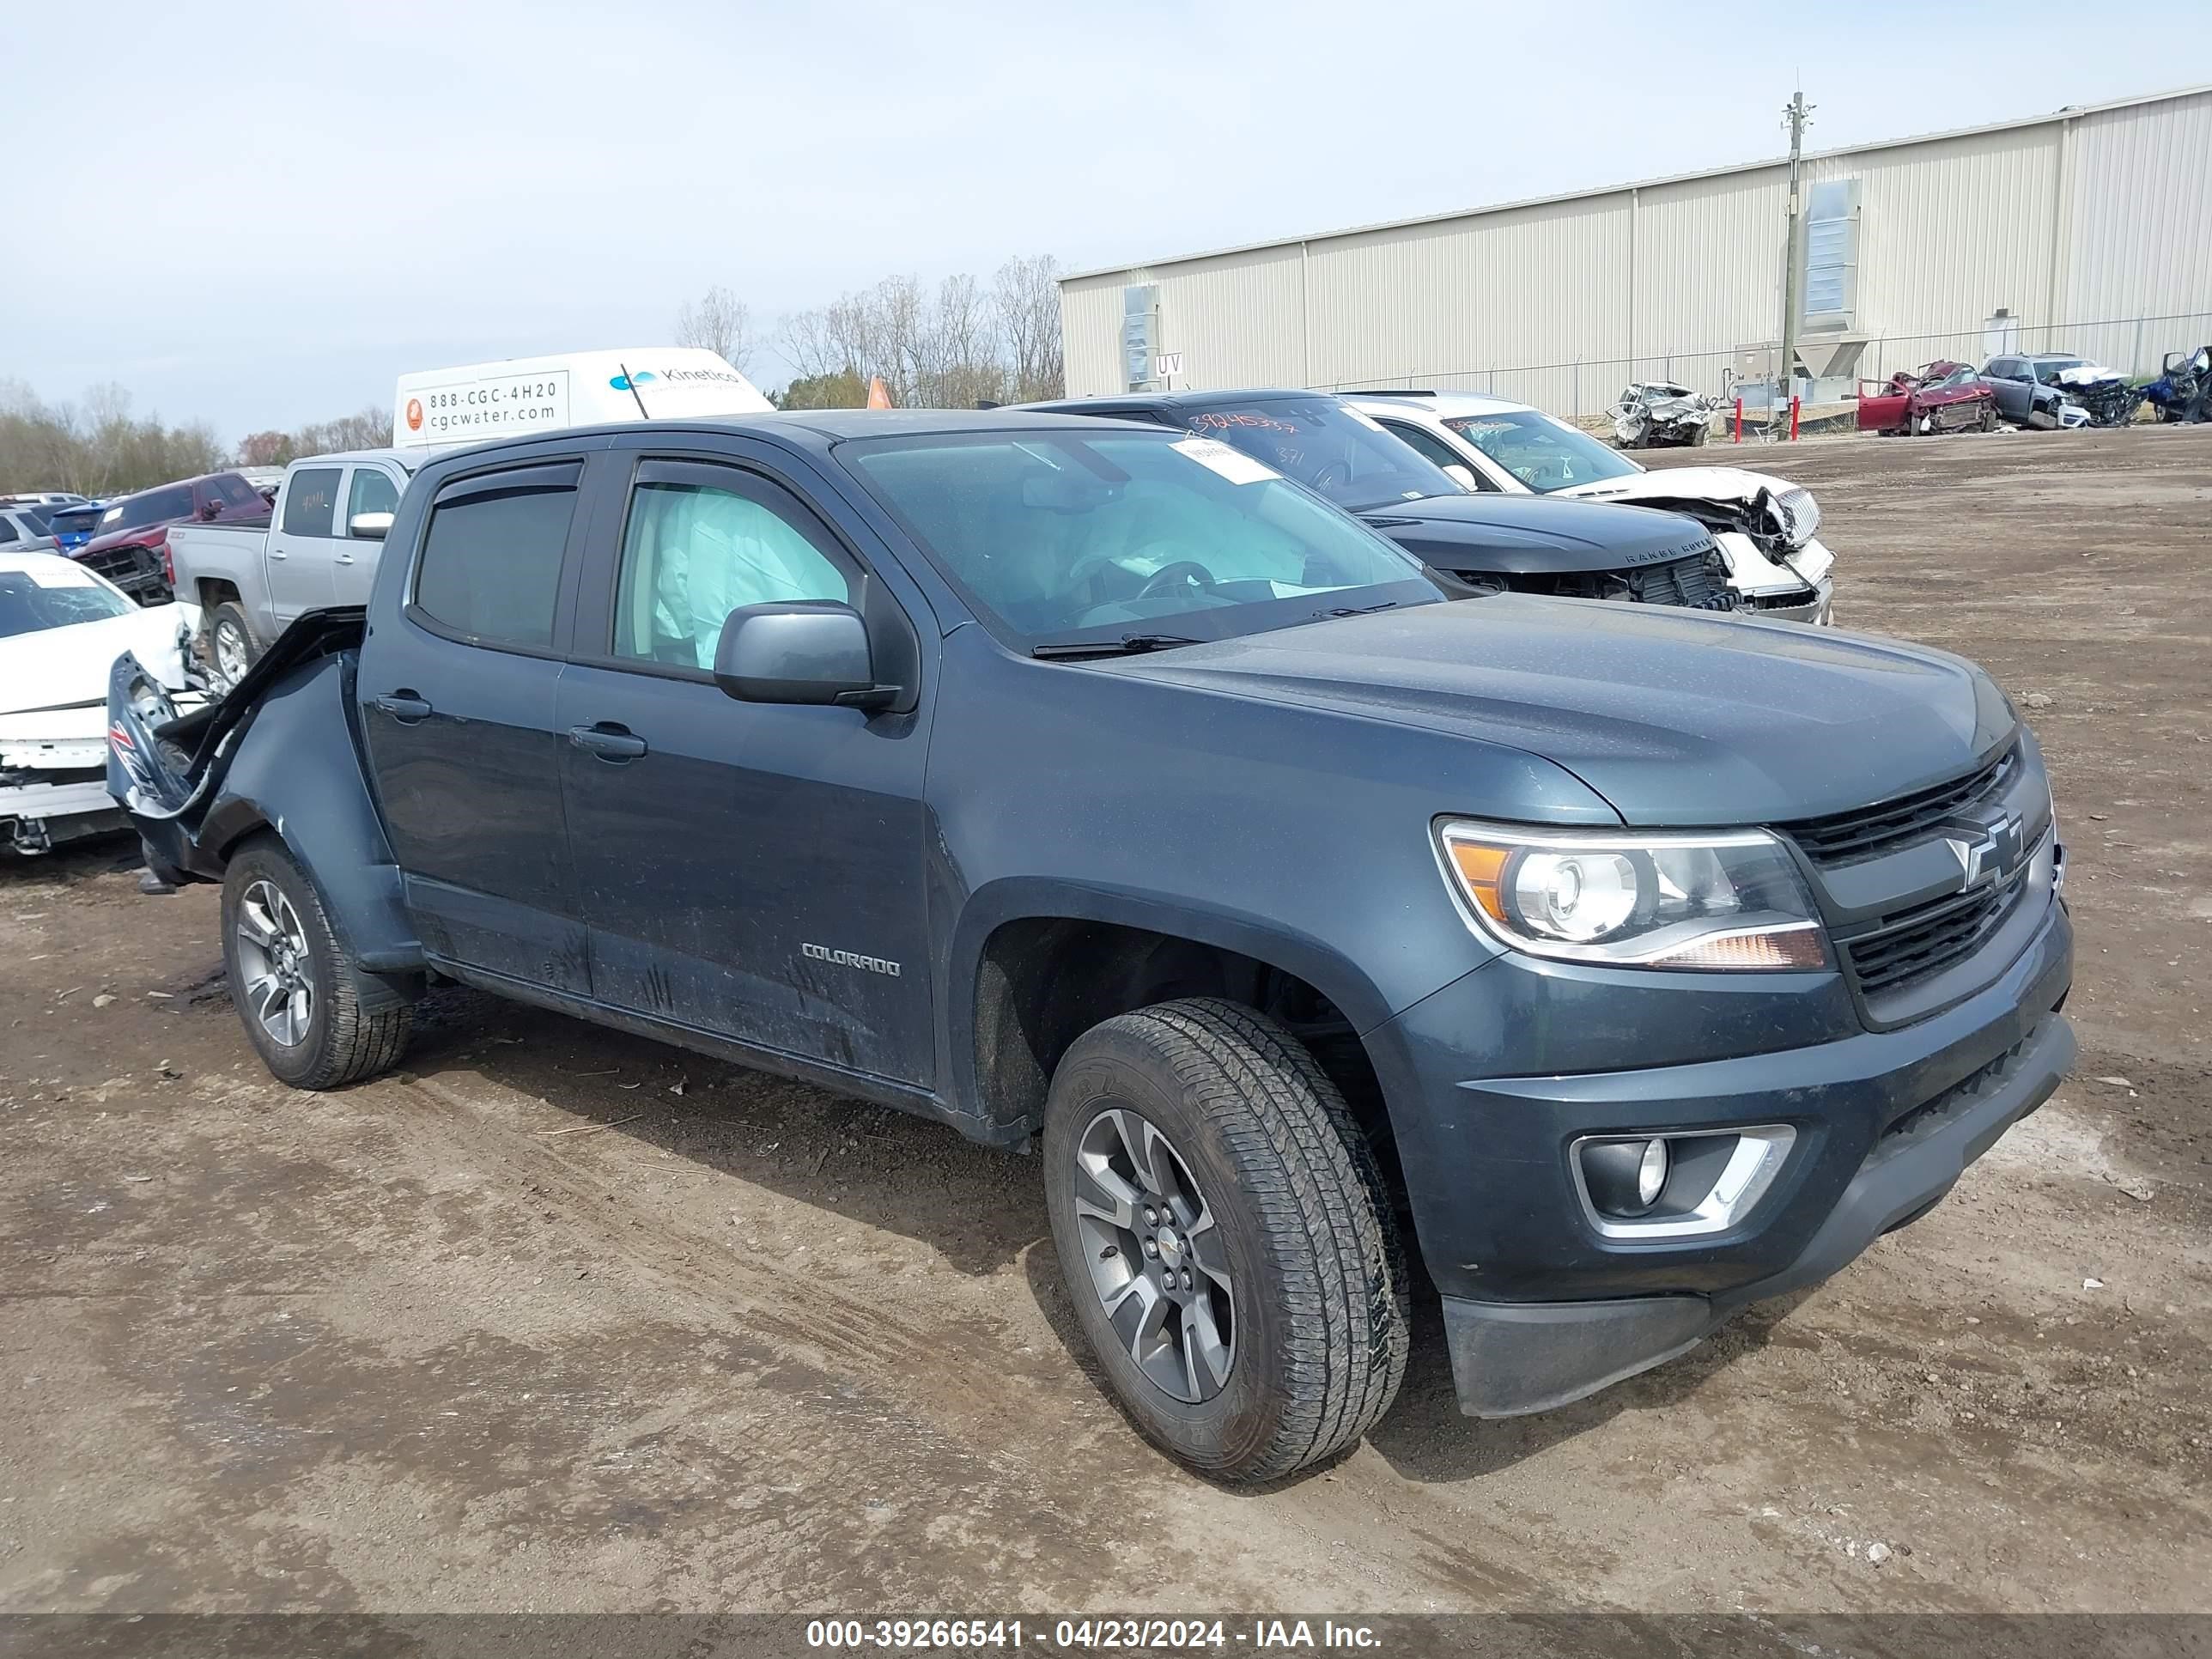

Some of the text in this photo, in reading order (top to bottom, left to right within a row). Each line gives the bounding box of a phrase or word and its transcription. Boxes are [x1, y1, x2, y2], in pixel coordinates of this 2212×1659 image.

[1158, 355, 1180, 374] UV
[661, 368, 739, 383] Kinetico
[430, 406, 555, 430] cgcwater.com
[1626, 548, 1676, 563] RANGE
[110, 720, 162, 799] Z71
[802, 942, 901, 977] COLORADO
